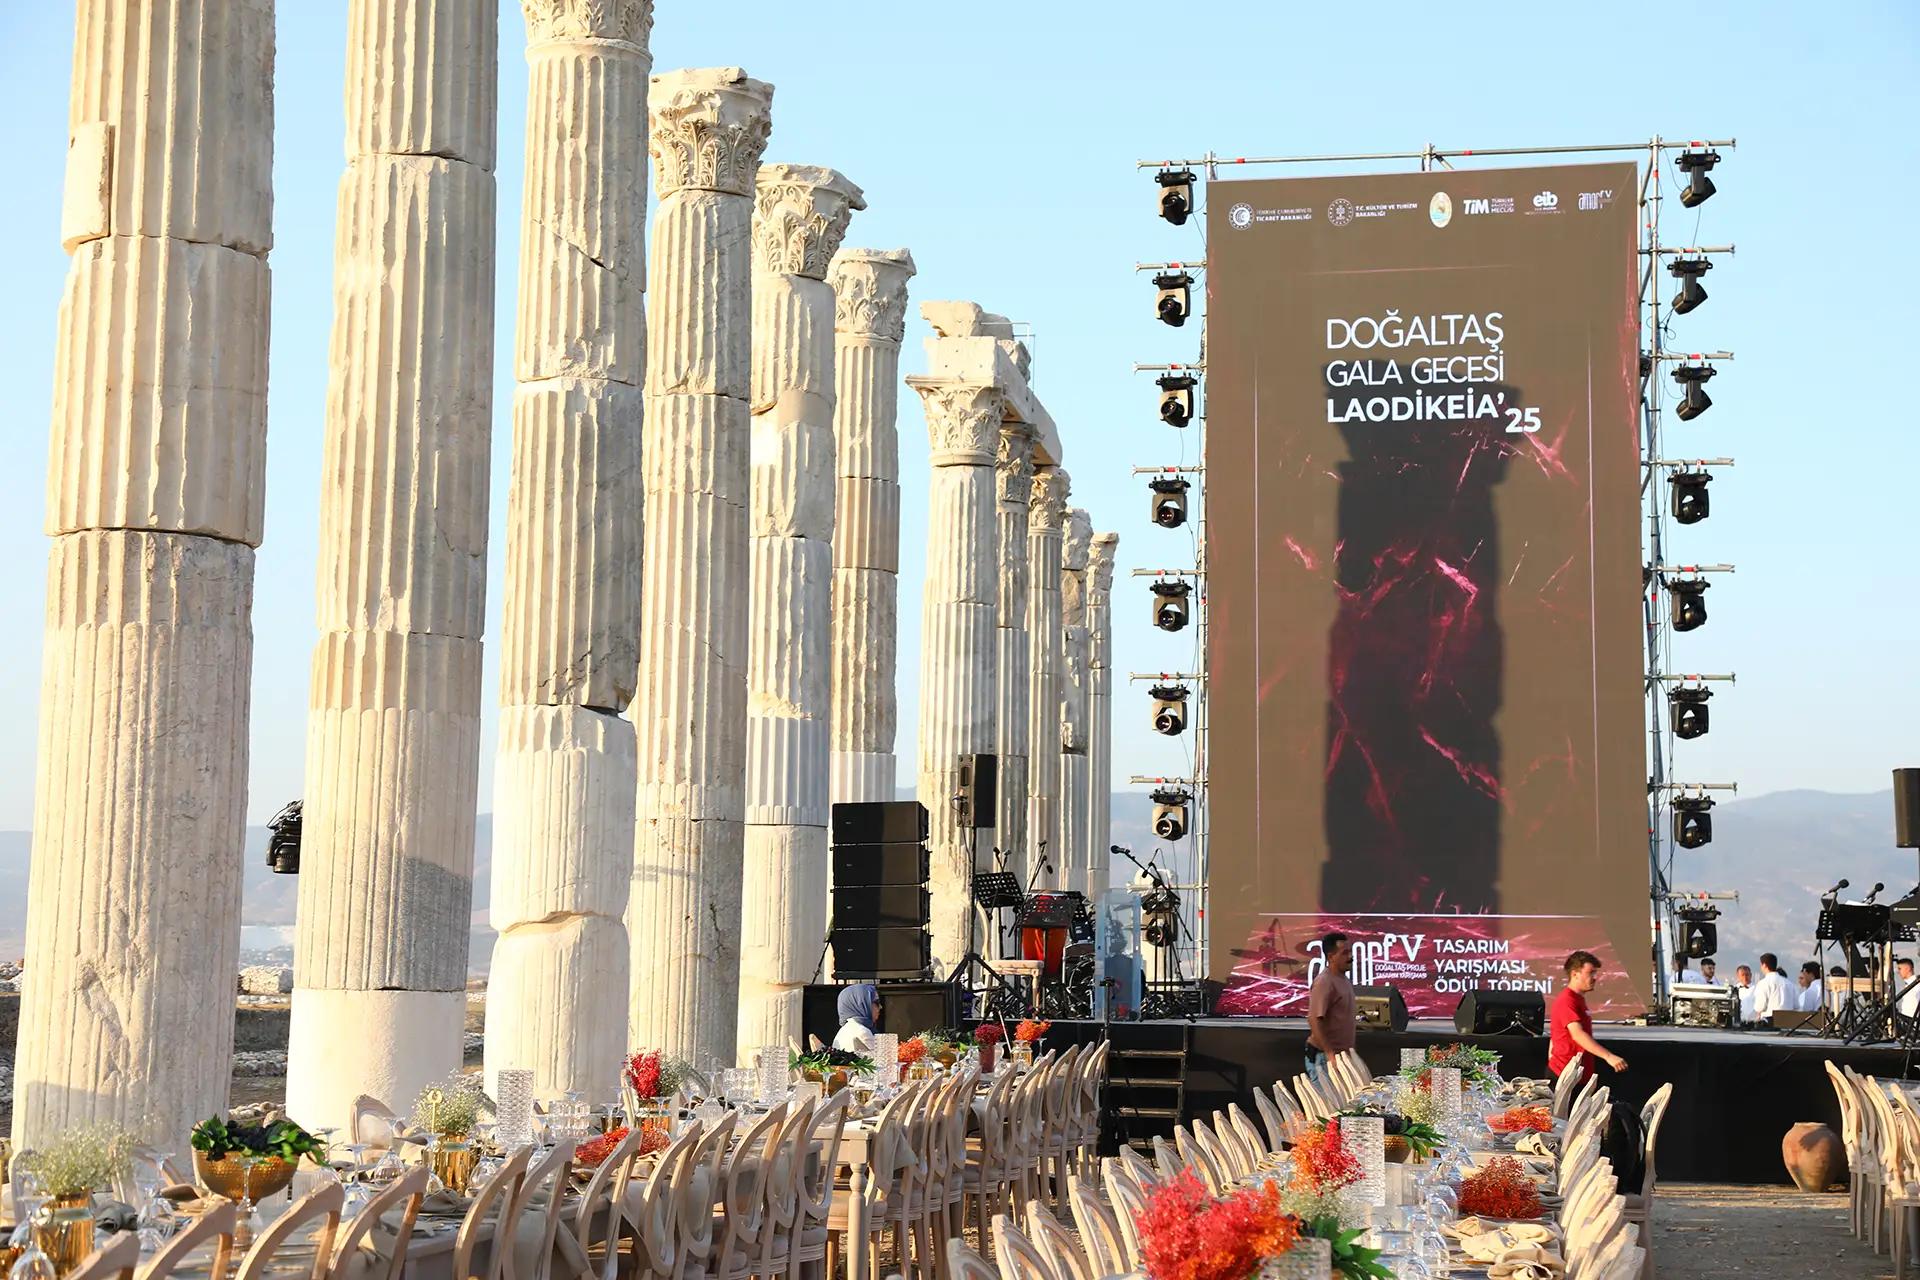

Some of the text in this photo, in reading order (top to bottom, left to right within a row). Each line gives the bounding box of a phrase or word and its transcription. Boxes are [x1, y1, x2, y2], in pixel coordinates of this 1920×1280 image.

[1533, 191, 1558, 207] eib
[1326, 308, 1504, 352] DOĞALTAŞ
[1326, 350, 1504, 387] GALA GECESİ
[1433, 939, 1509, 954] TASARIM
[1433, 958, 1526, 978] YARIŞMASI
[1487, 975, 1552, 994] TÖRENİ
